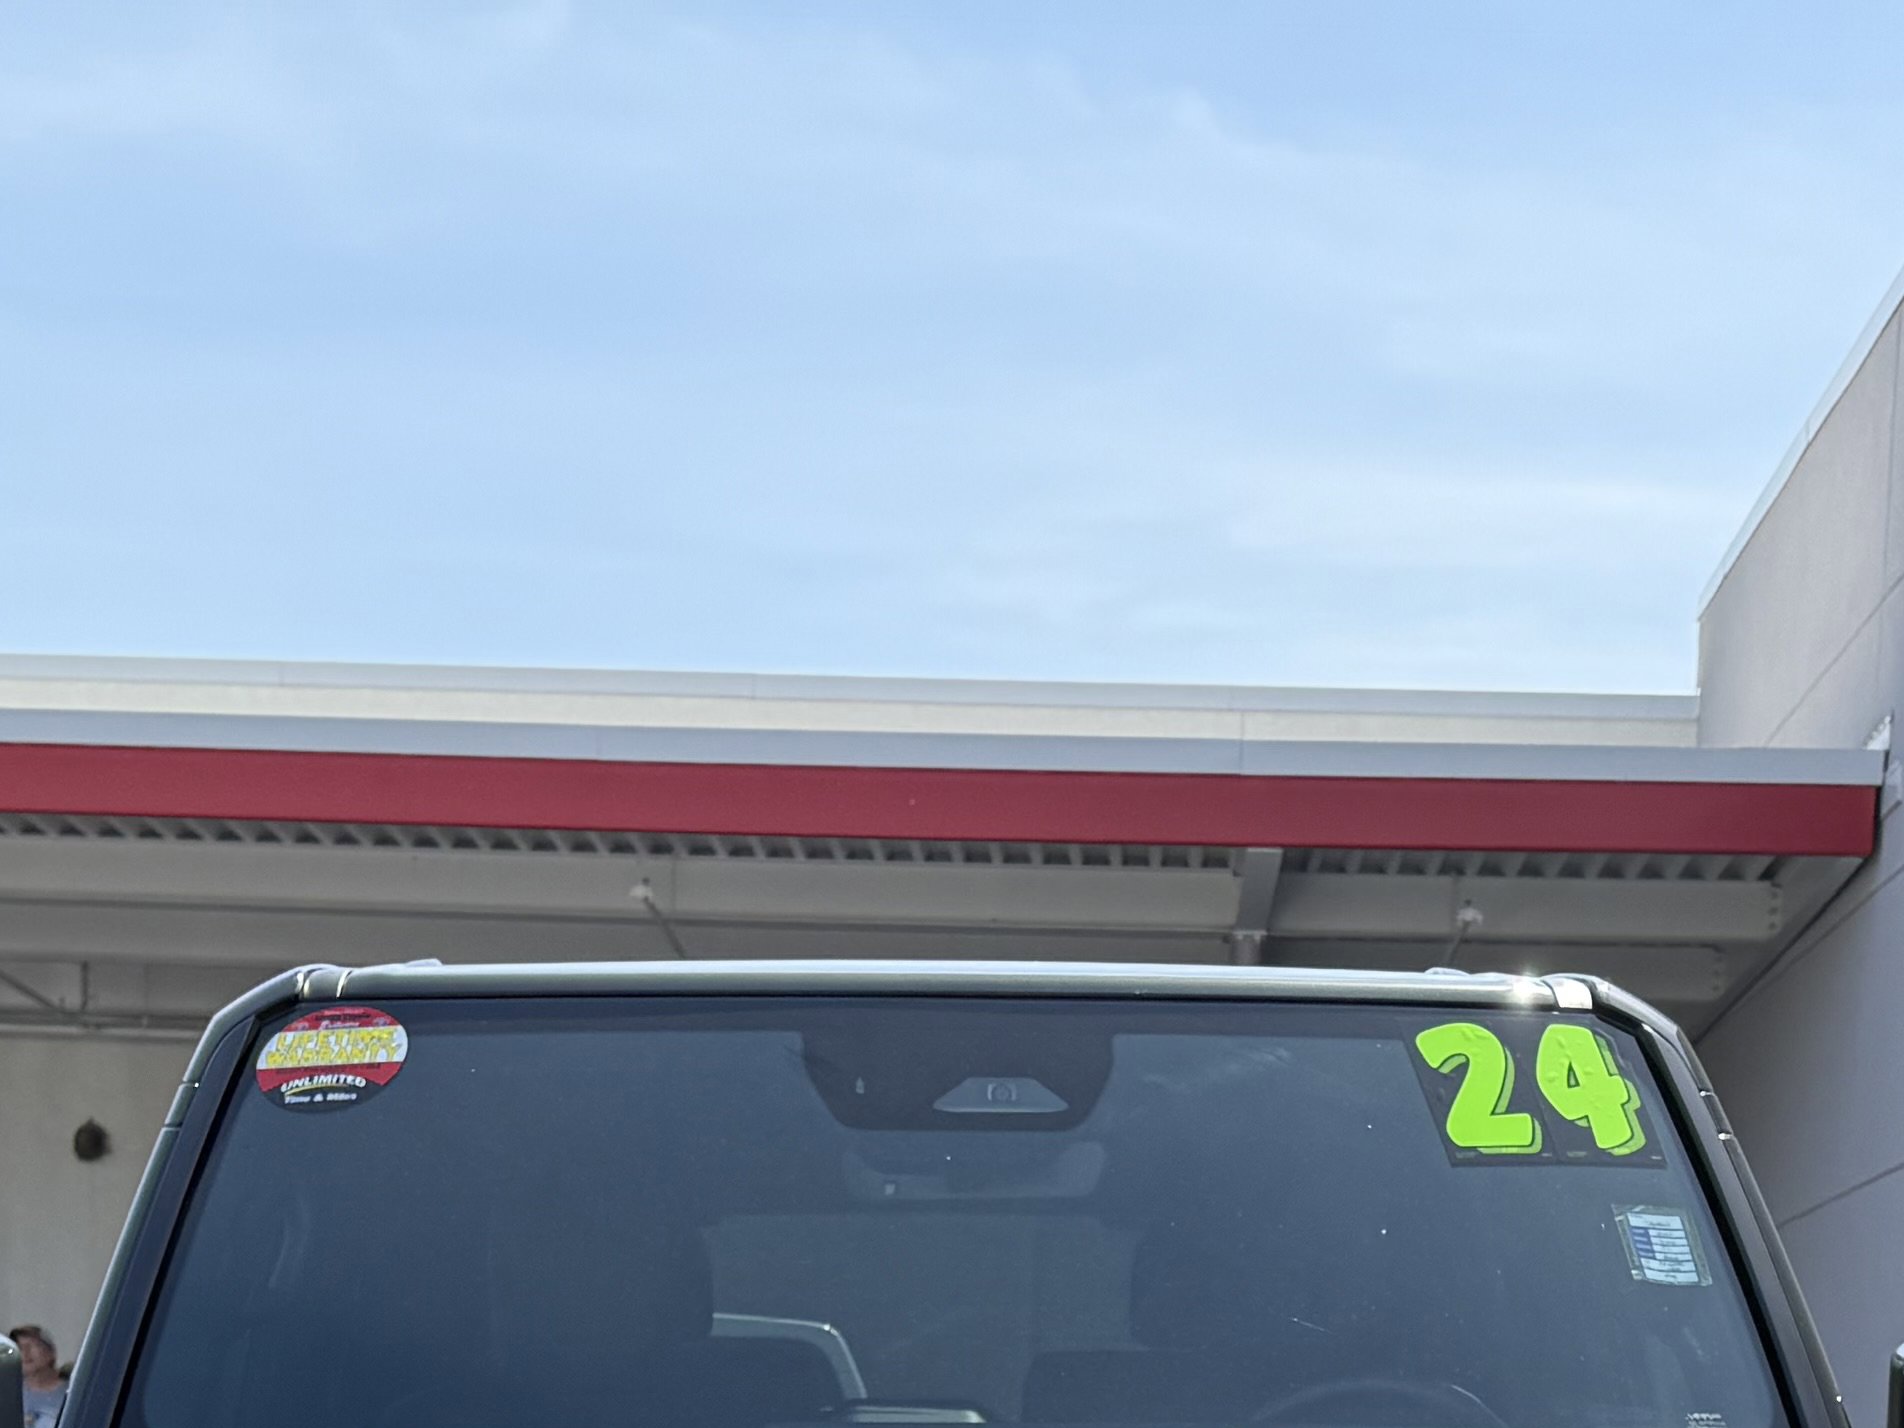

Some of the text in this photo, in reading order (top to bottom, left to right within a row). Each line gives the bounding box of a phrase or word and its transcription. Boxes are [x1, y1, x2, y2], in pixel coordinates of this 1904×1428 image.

[275, 1028, 395, 1050] LIFETIME
[265, 1043, 402, 1067] WARRANTY
[280, 1074, 367, 1093] UNLIMITED
[1415, 1022, 1645, 1155] 24
